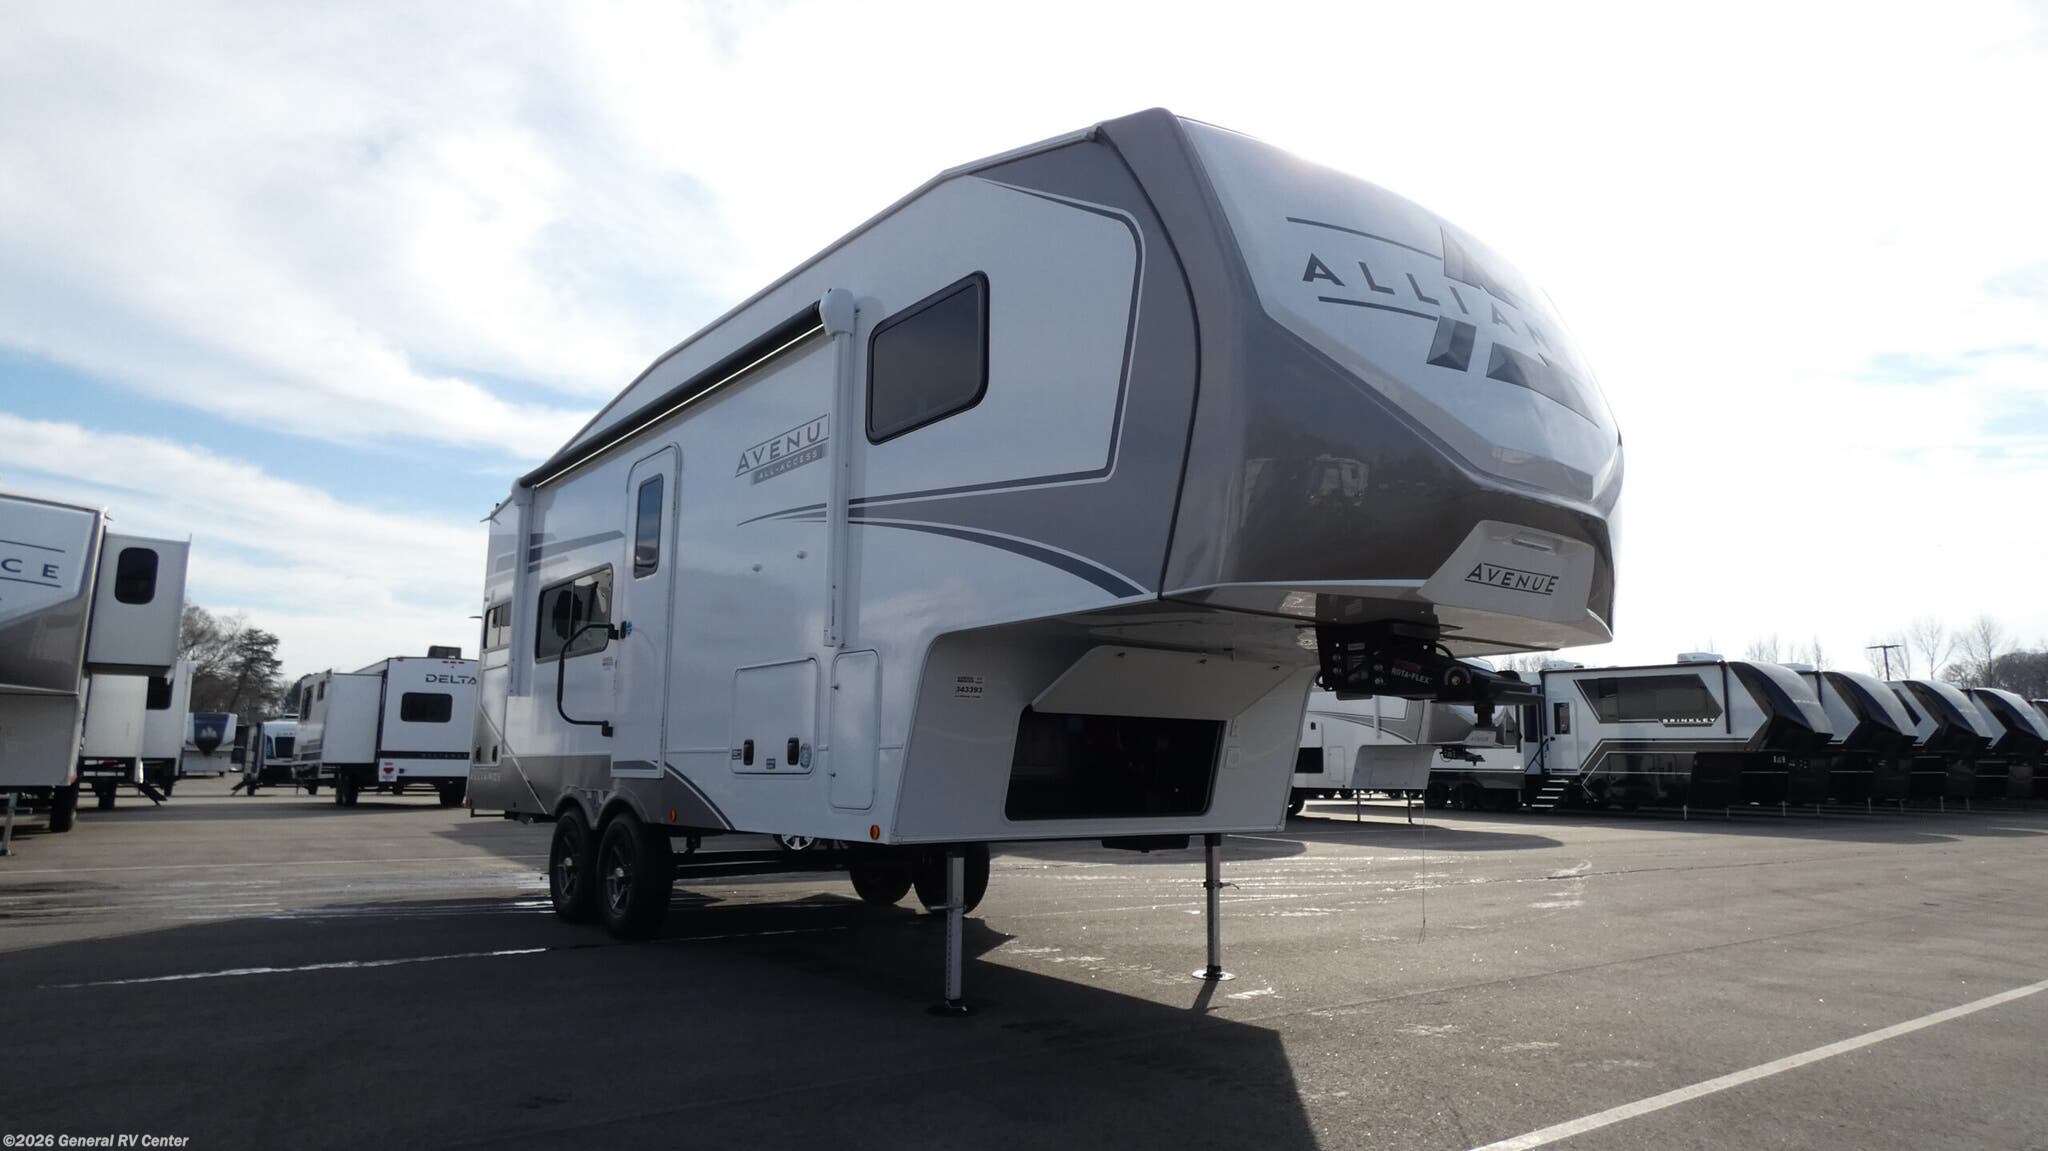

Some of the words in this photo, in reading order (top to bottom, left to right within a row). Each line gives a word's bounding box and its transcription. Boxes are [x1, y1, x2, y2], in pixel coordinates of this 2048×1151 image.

[1303, 253, 1552, 353] ALLIAN
[1466, 563, 1559, 593] AVENUE
[425, 674, 478, 685] DELTA
